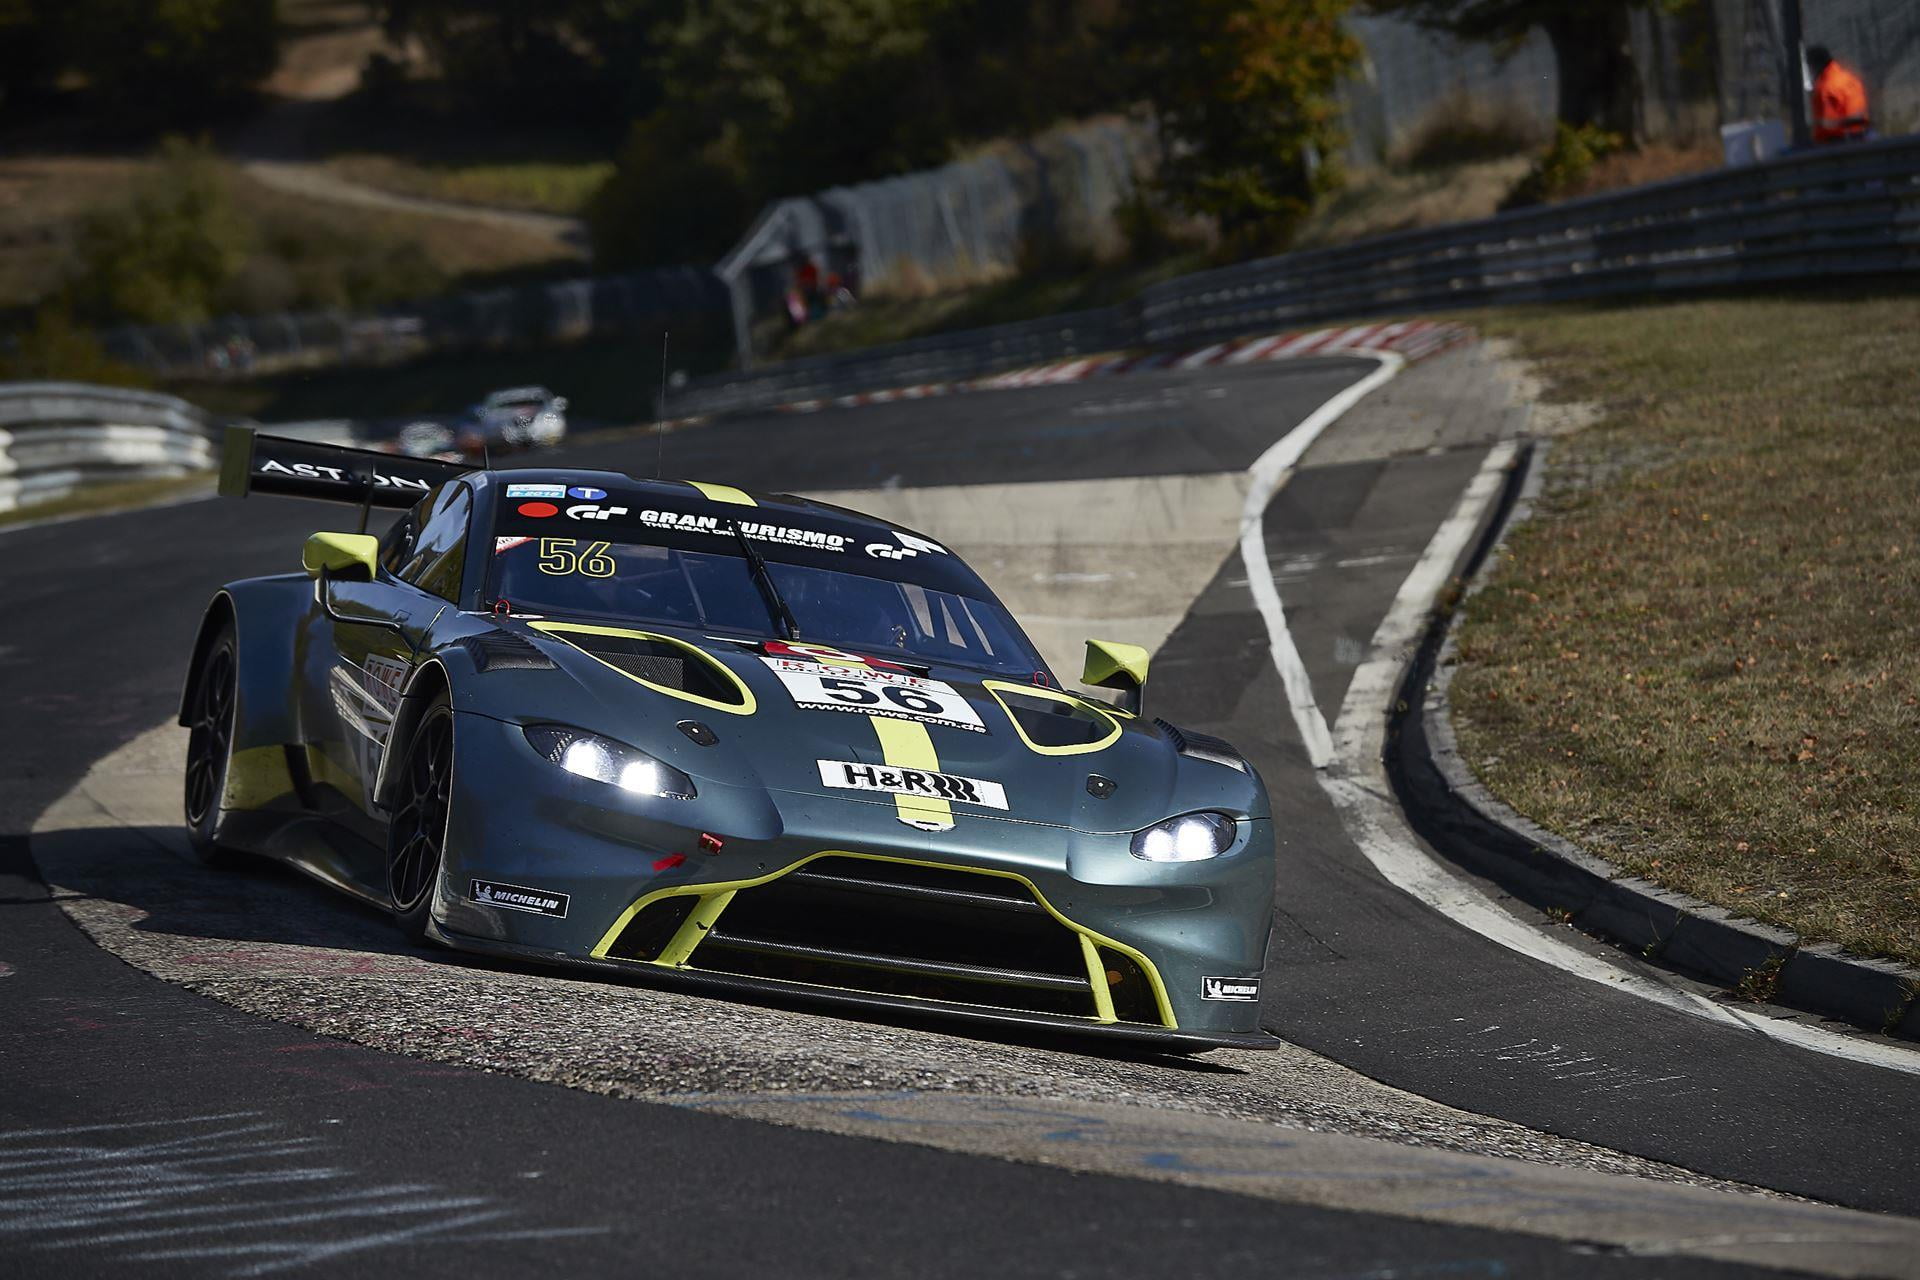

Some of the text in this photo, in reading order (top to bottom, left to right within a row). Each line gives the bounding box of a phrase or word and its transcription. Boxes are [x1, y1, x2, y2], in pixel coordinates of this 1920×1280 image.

[577, 487, 600, 499] T
[639, 509, 844, 548] GRAN URISMO
[642, 520, 845, 553] THE REAL DRIING SIMULATOR
[538, 536, 616, 578] 56
[818, 676, 945, 715] 56
[797, 701, 987, 734] www.rowe.com.de
[493, 890, 560, 910] MICHELIN
